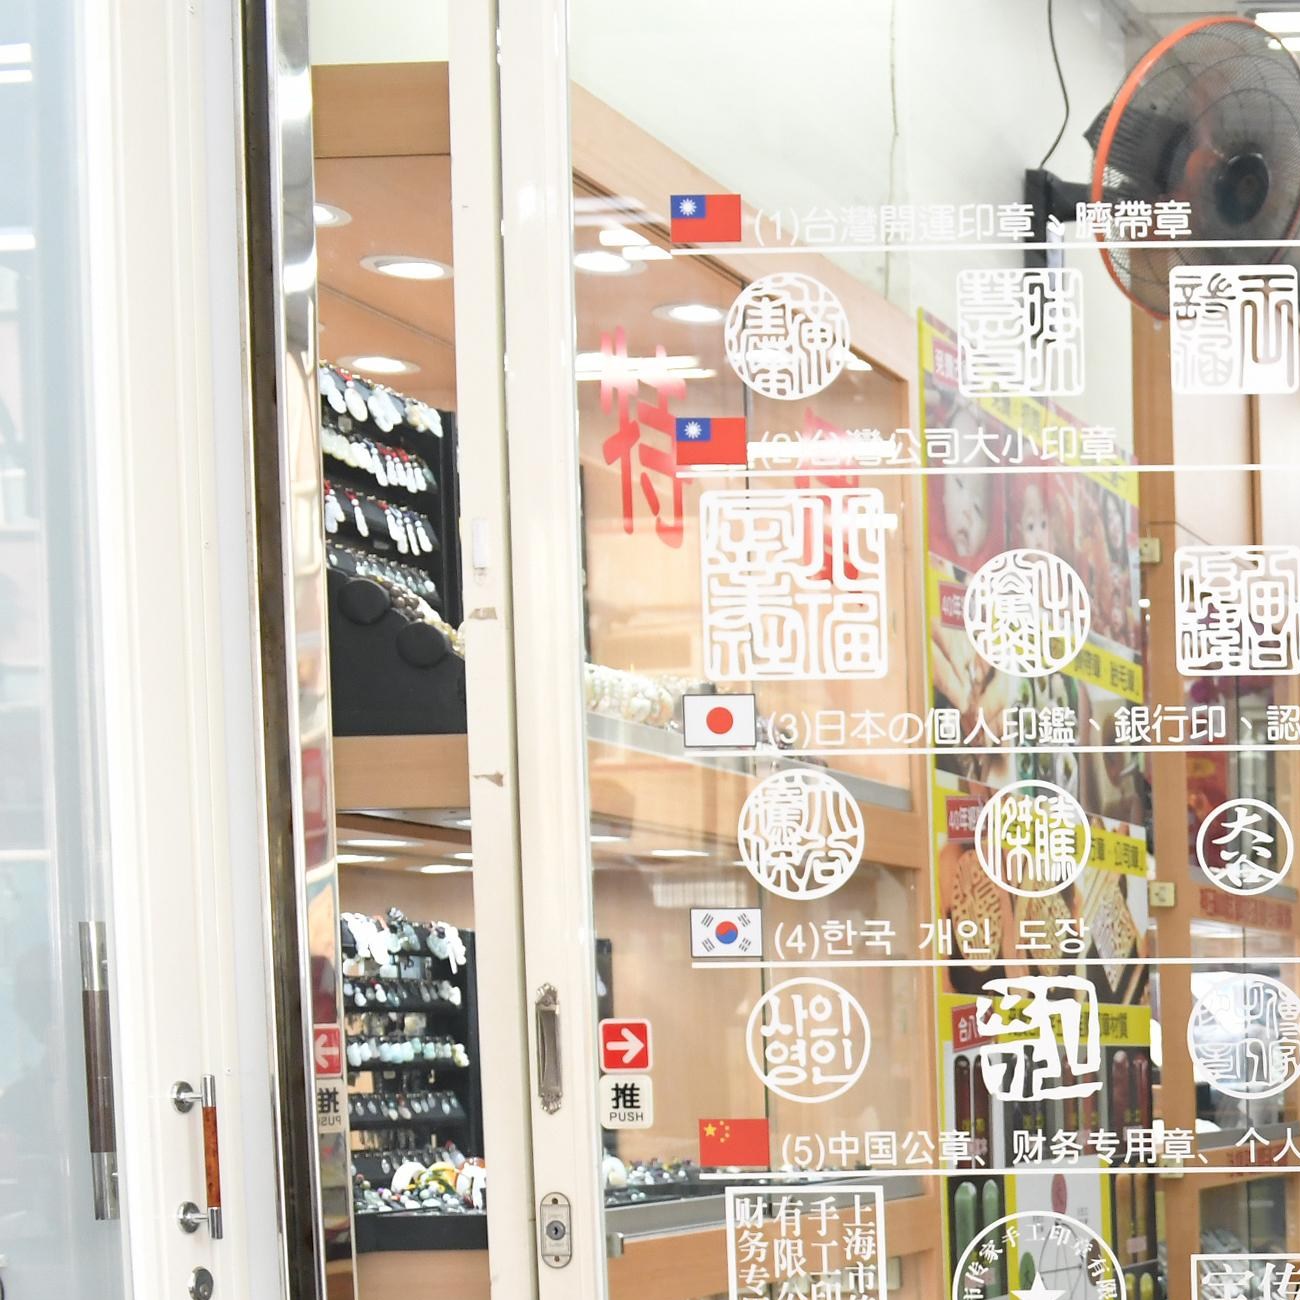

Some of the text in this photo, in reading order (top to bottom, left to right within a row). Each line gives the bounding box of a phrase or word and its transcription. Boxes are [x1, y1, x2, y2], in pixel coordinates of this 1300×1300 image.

[917, 916, 992, 956] 개인
[1015, 916, 1090, 954] 도장
[611, 1082, 641, 1110] 推
[609, 1111, 645, 1123] PUSH
